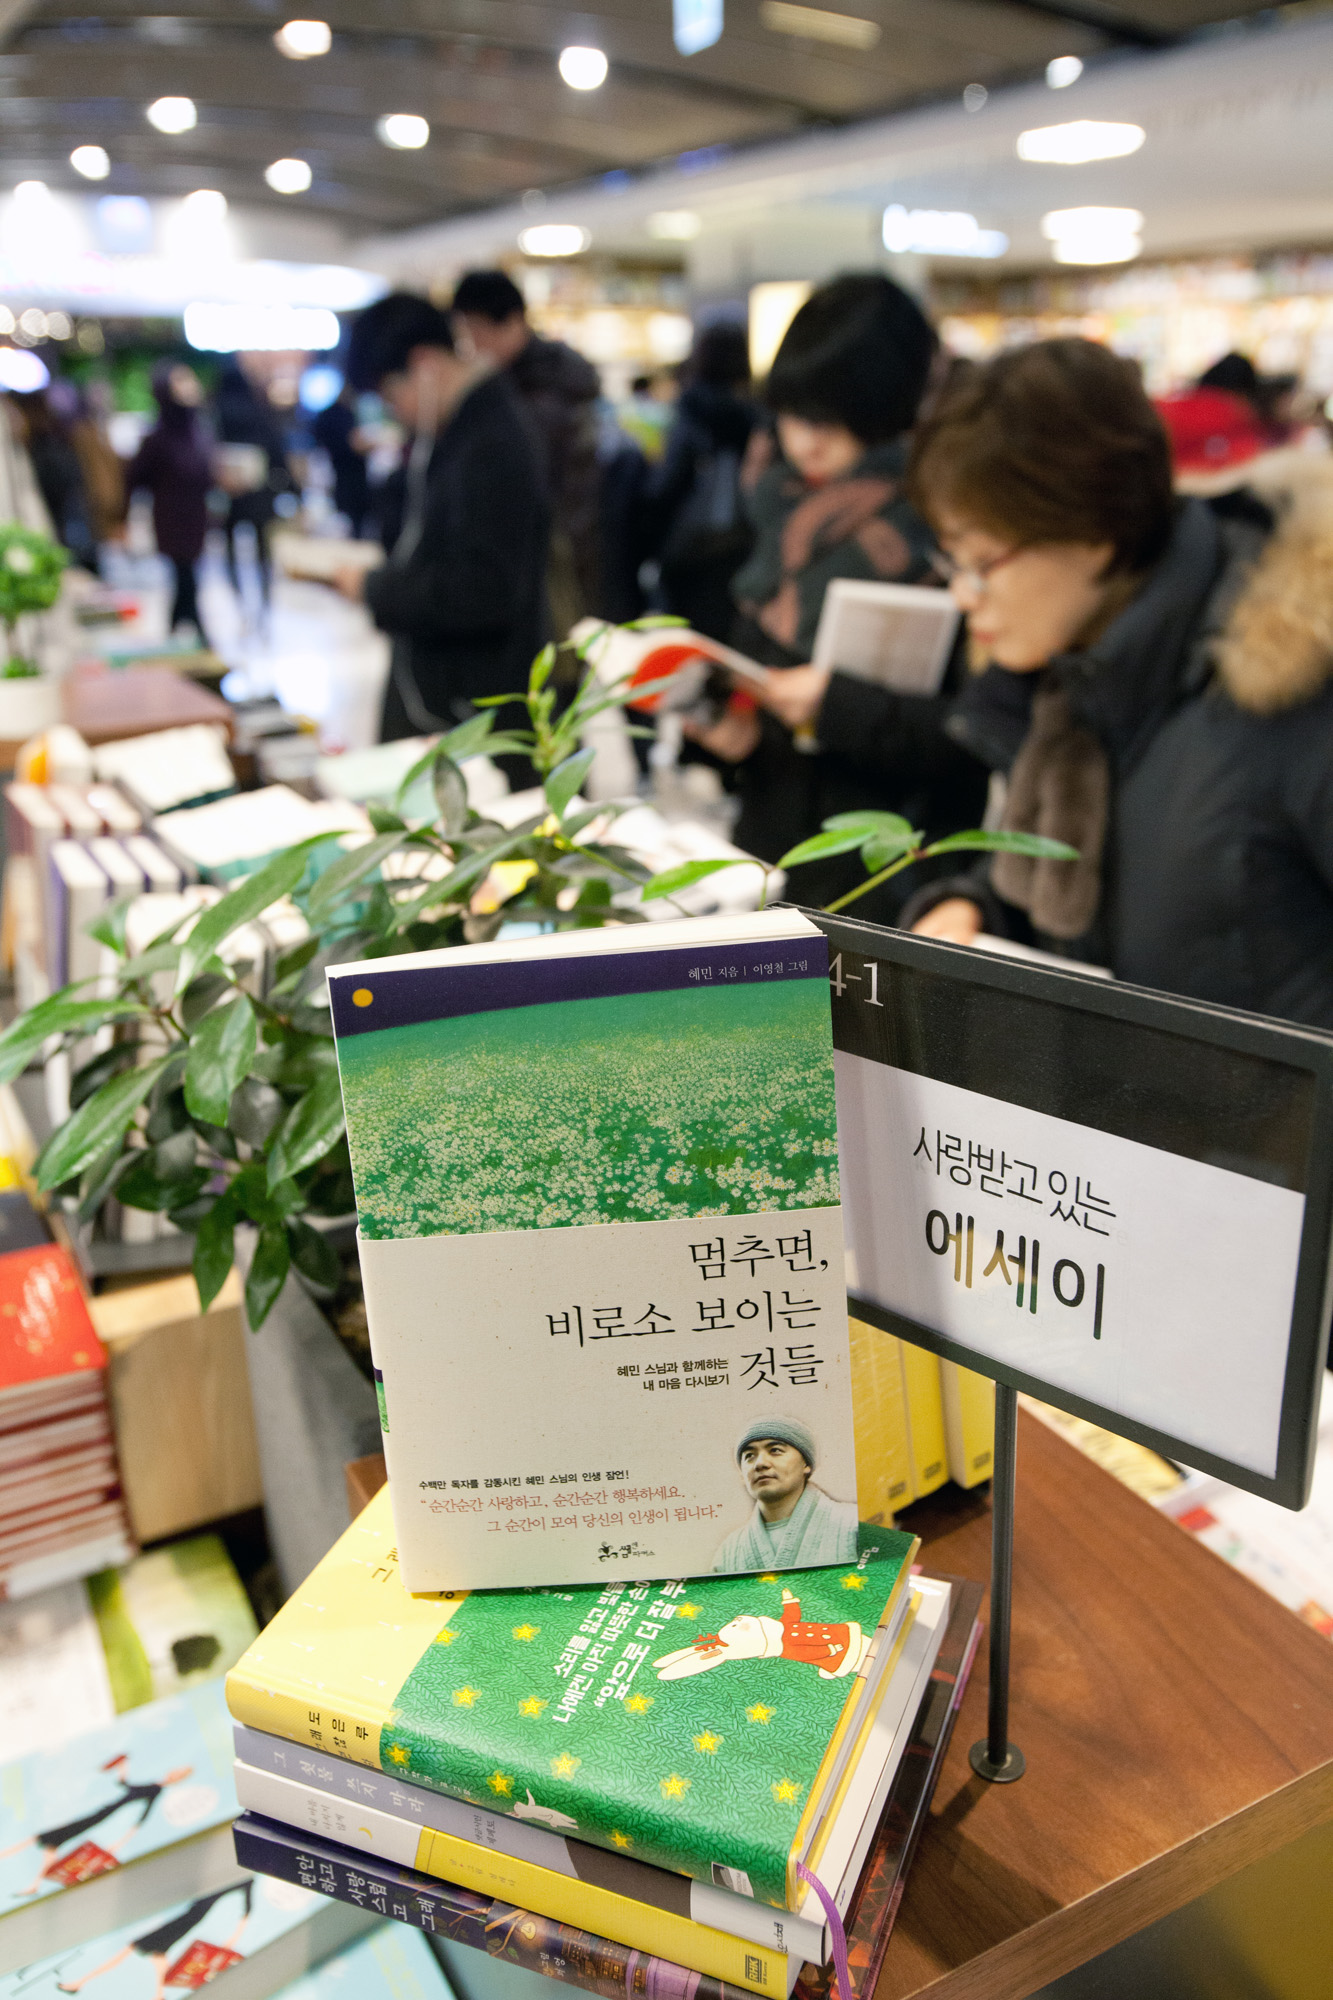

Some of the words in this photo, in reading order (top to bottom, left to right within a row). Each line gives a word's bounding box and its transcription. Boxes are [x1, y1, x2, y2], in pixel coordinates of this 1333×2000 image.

[688, 966, 713, 981] 혜민
[717, 965, 739, 979] 지음
[753, 961, 784, 976] 이영철
[788, 959, 809, 972] 그림
[912, 1126, 1044, 1205] 사랑받고
[1048, 1170, 1117, 1237] 있는
[688, 1229, 829, 1281] 멈추면,
[925, 1209, 1106, 1341] 에세이
[545, 1303, 676, 1348] 비로소
[691, 1290, 822, 1333] 보이는
[616, 1364, 641, 1377] 혜민
[644, 1361, 678, 1375] 스님과
[682, 1357, 729, 1373] 함께하는
[739, 1344, 825, 1391] 것들
[643, 1378, 655, 1391] 내
[658, 1376, 682, 1391] 마음
[685, 1373, 730, 1389] 다시보기
[418, 1480, 447, 1490] 수백만
[451, 1479, 479, 1489] 독자를
[483, 1476, 522, 1488] 감동시킨
[525, 1475, 545, 1486] 혜민
[549, 1473, 578, 1484] 스님의
[582, 1471, 601, 1482] 인생
[605, 1470, 630, 1481] 잠언!
[552, 1489, 608, 1508] 순간순간
[612, 1485, 686, 1503] 행복하세요.
[487, 1521, 502, 1532] 그
[504, 1516, 546, 1533] 순간이
[551, 1514, 578, 1529] 모여
[582, 1511, 624, 1528] 당신의
[628, 1508, 669, 1525] 인생이
[857, 1546, 880, 1570] 예담
[647, 1600, 678, 1620] 잘
[553, 1634, 592, 1679] 소리를
[579, 1607, 609, 1634] 잃고
[635, 1620, 666, 1641] 더
[552, 1674, 594, 1723] 나에겐
[581, 1643, 613, 1673] 아직
[600, 1601, 640, 1642] 따뜻한
[346, 1778, 378, 1799] 쓰지
[389, 1787, 425, 1813] 마라
[416, 1897, 436, 1931] 그래
[746, 1955, 761, 1983] RHK
